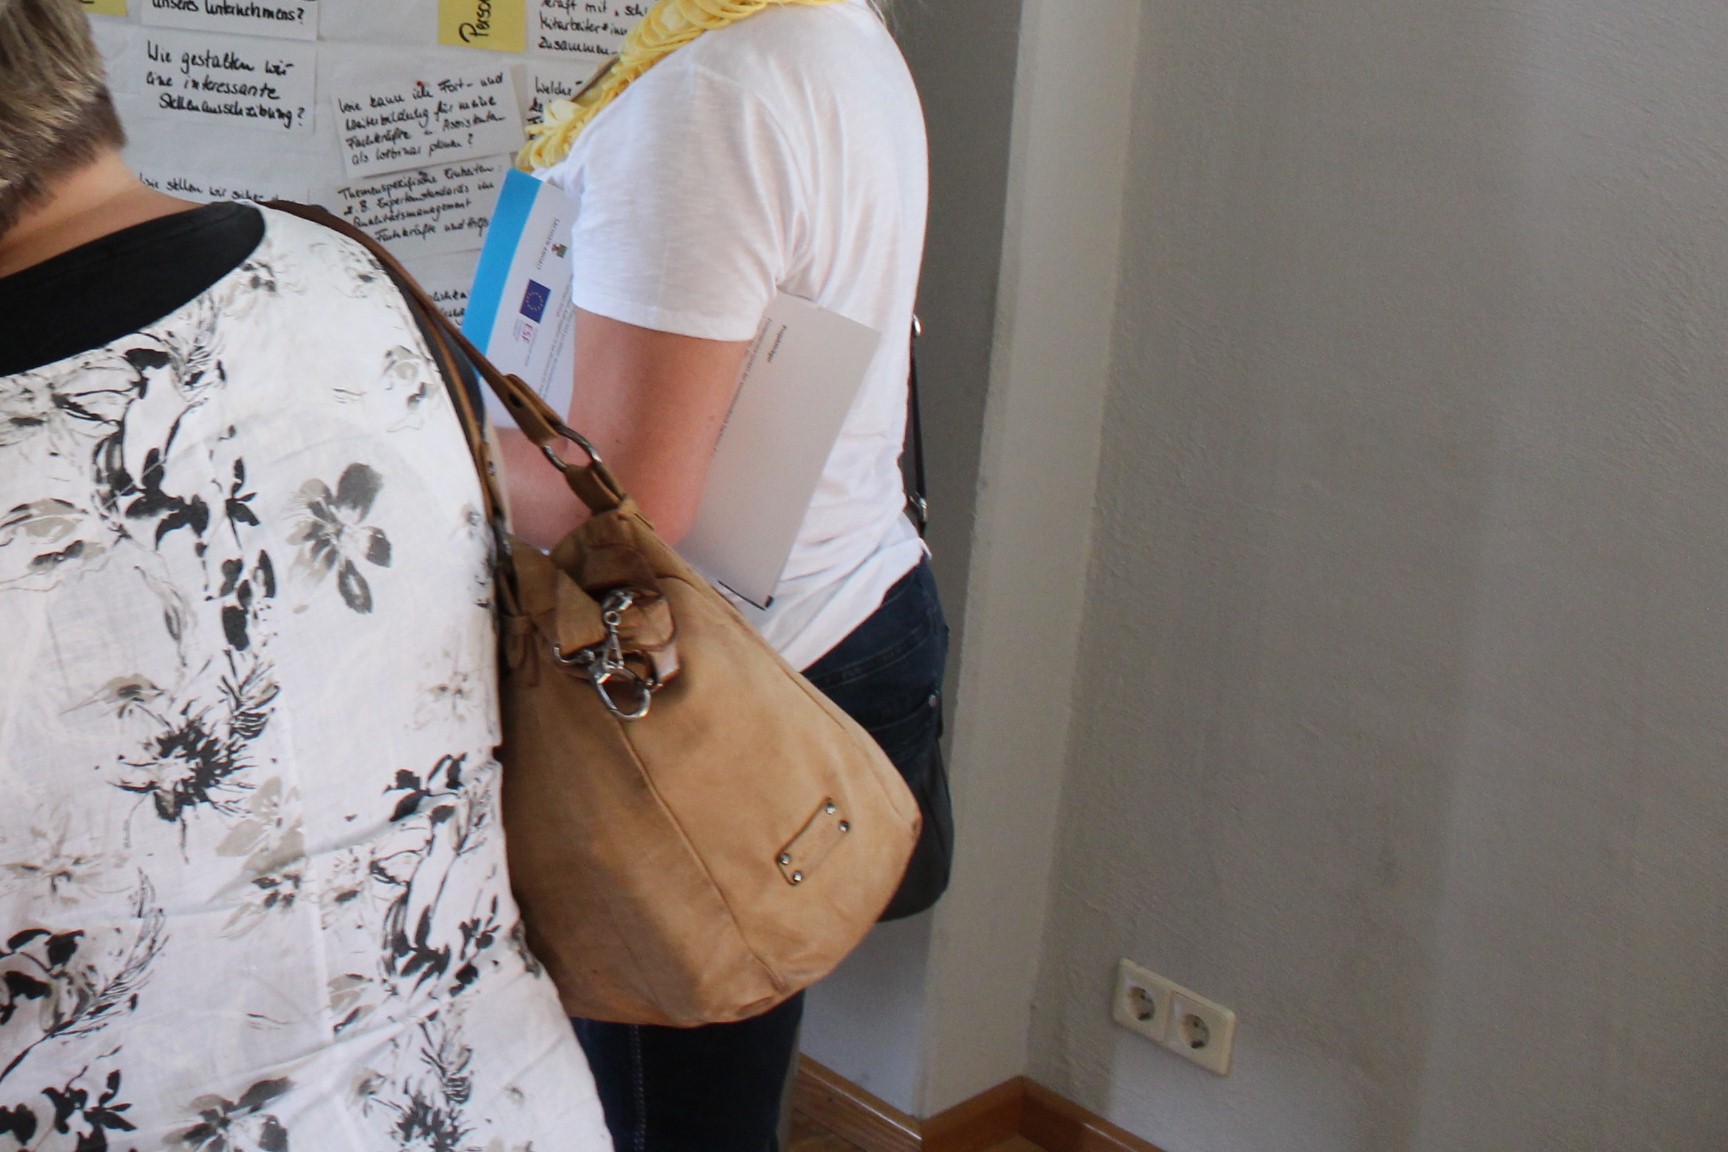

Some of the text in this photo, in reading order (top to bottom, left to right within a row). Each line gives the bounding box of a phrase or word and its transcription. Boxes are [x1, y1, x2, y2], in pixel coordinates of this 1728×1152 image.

[585, 0, 608, 14] mit
[147, 39, 173, 64] Wie
[181, 48, 256, 75] gestalten
[146, 70, 282, 100] eine interessante
[369, 93, 405, 109] kann
[433, 100, 454, 122] für
[351, 151, 369, 166] als
